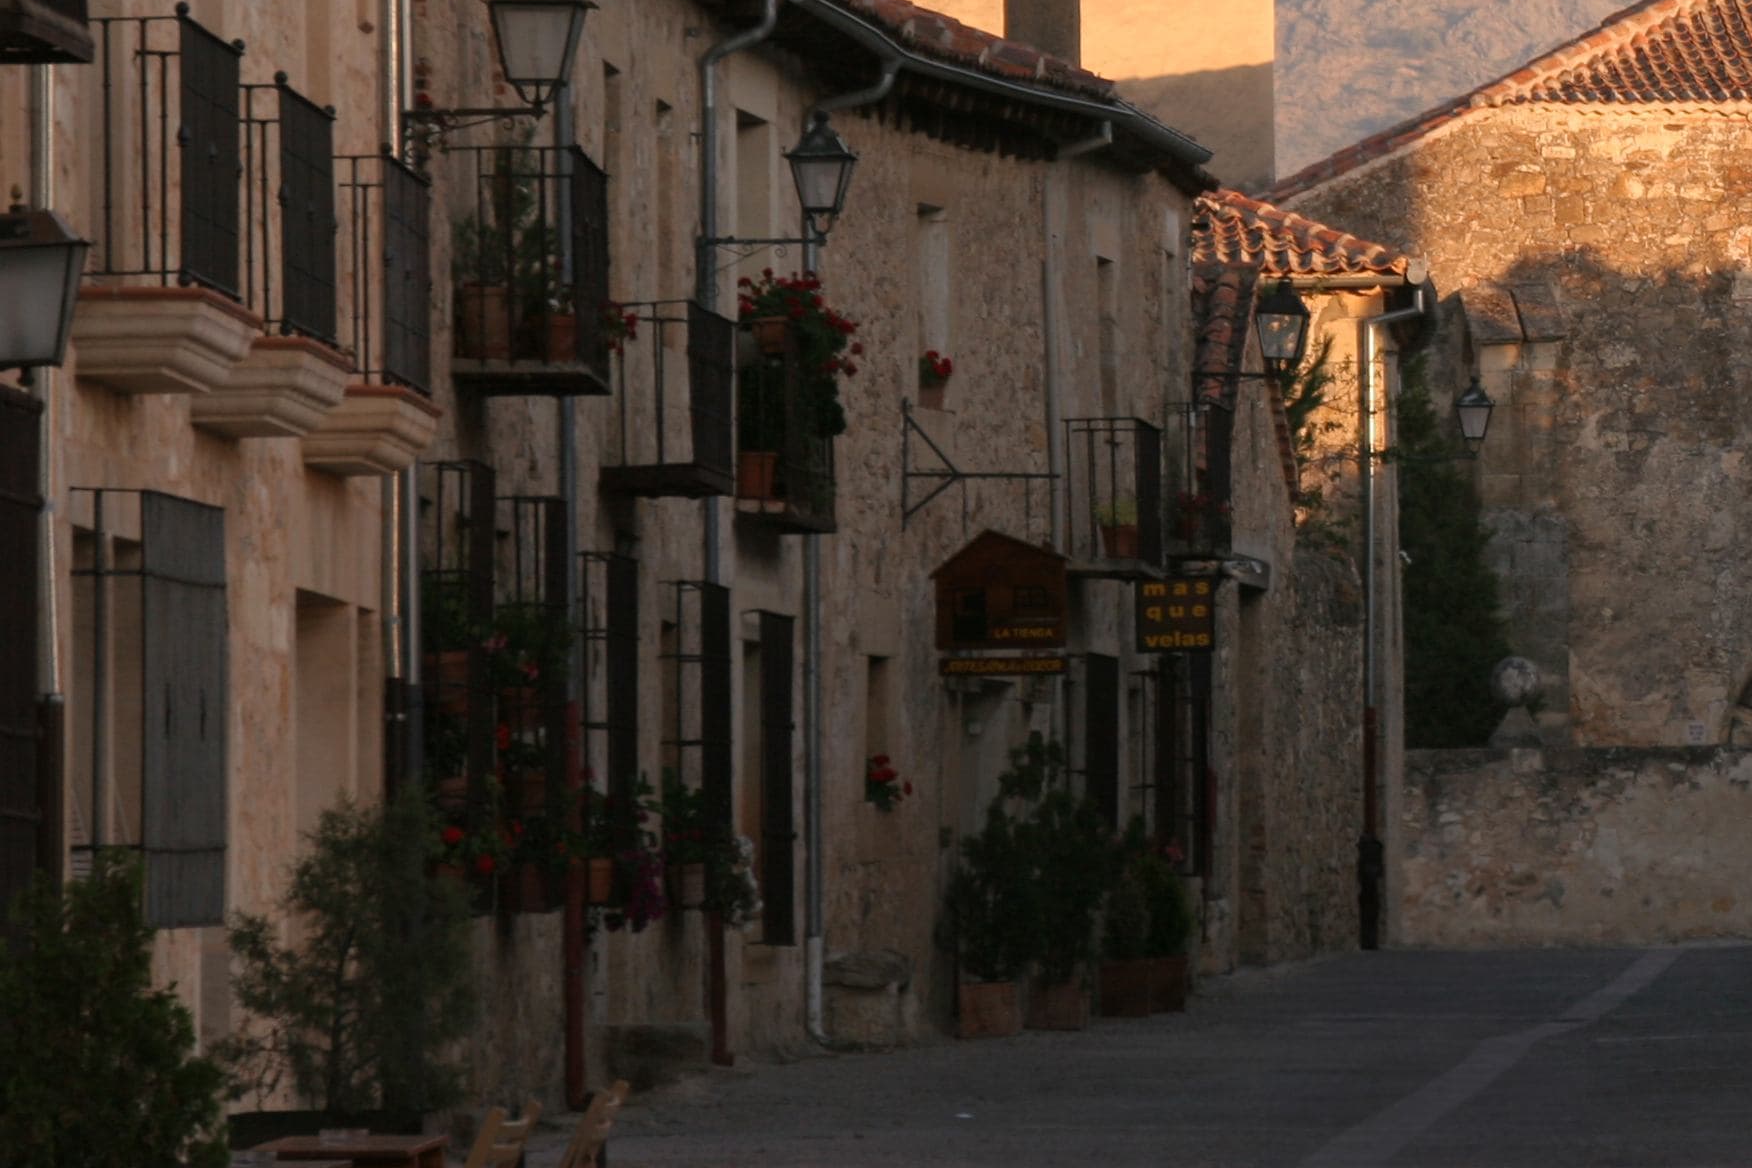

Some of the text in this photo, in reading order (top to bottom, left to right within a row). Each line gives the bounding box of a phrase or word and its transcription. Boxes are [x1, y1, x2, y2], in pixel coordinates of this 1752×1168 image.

[1143, 581, 1209, 597] mas
[1145, 604, 1207, 623] que
[1143, 629, 1210, 648] velas
